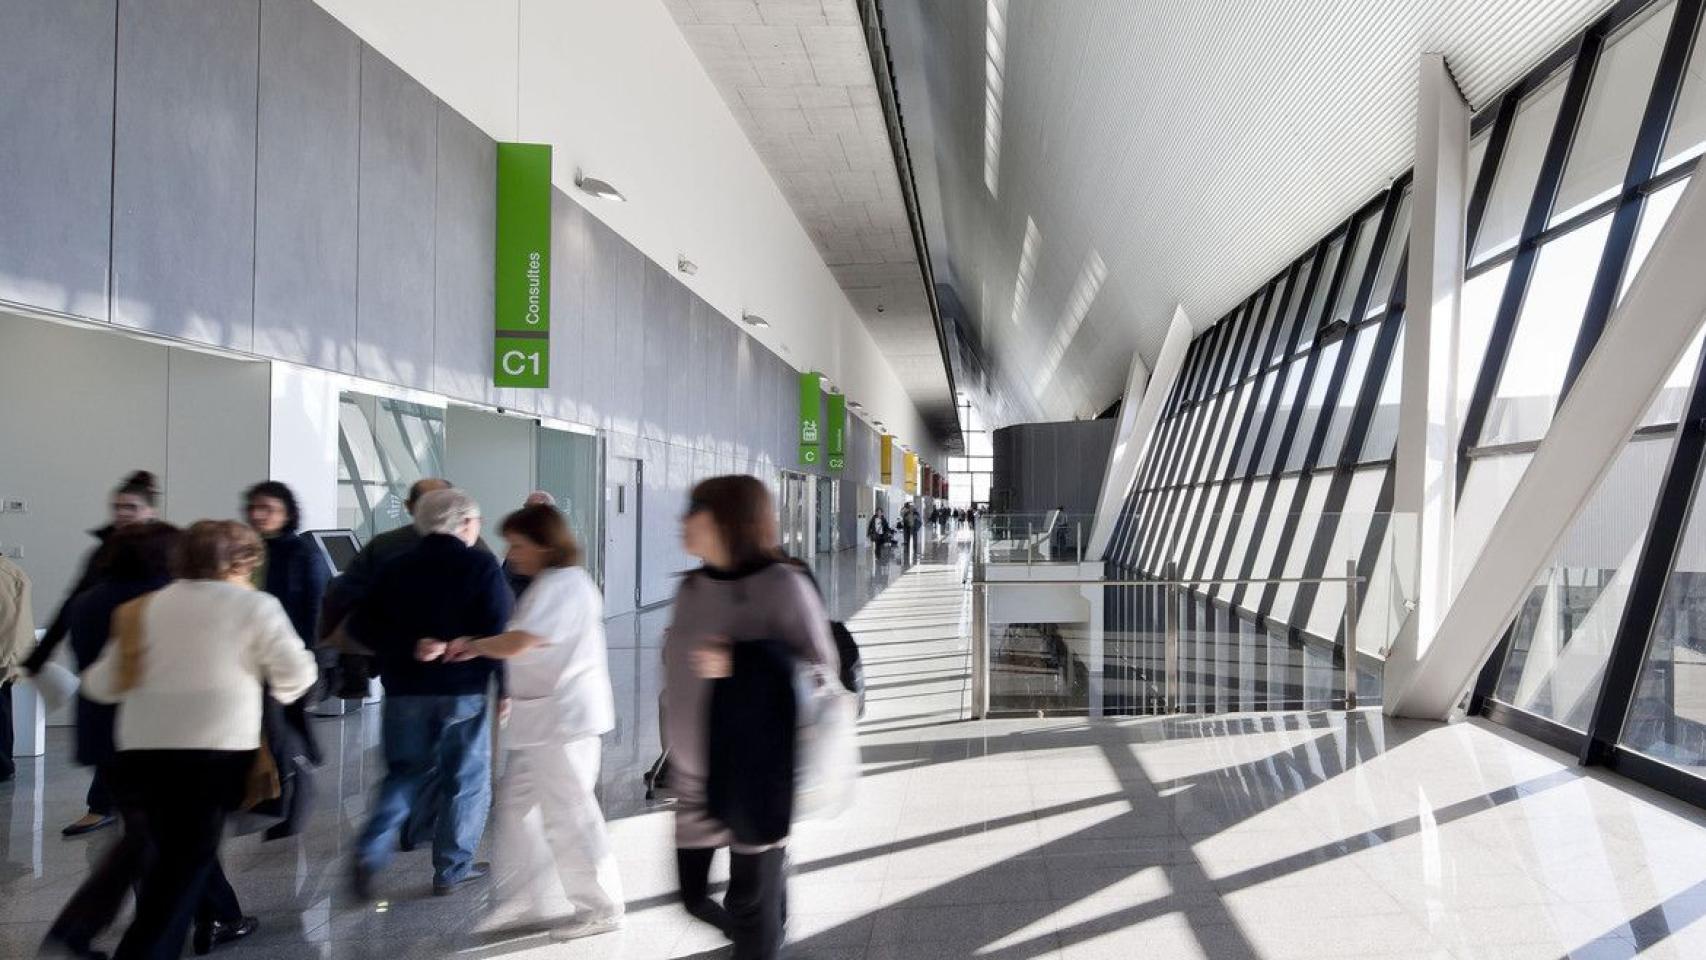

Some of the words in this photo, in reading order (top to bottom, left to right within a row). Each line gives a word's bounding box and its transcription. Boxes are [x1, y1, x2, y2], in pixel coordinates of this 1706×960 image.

[526, 252, 540, 324] Consultes
[502, 350, 540, 376] C1
[805, 451, 814, 462] C
[829, 459, 844, 468] C2
